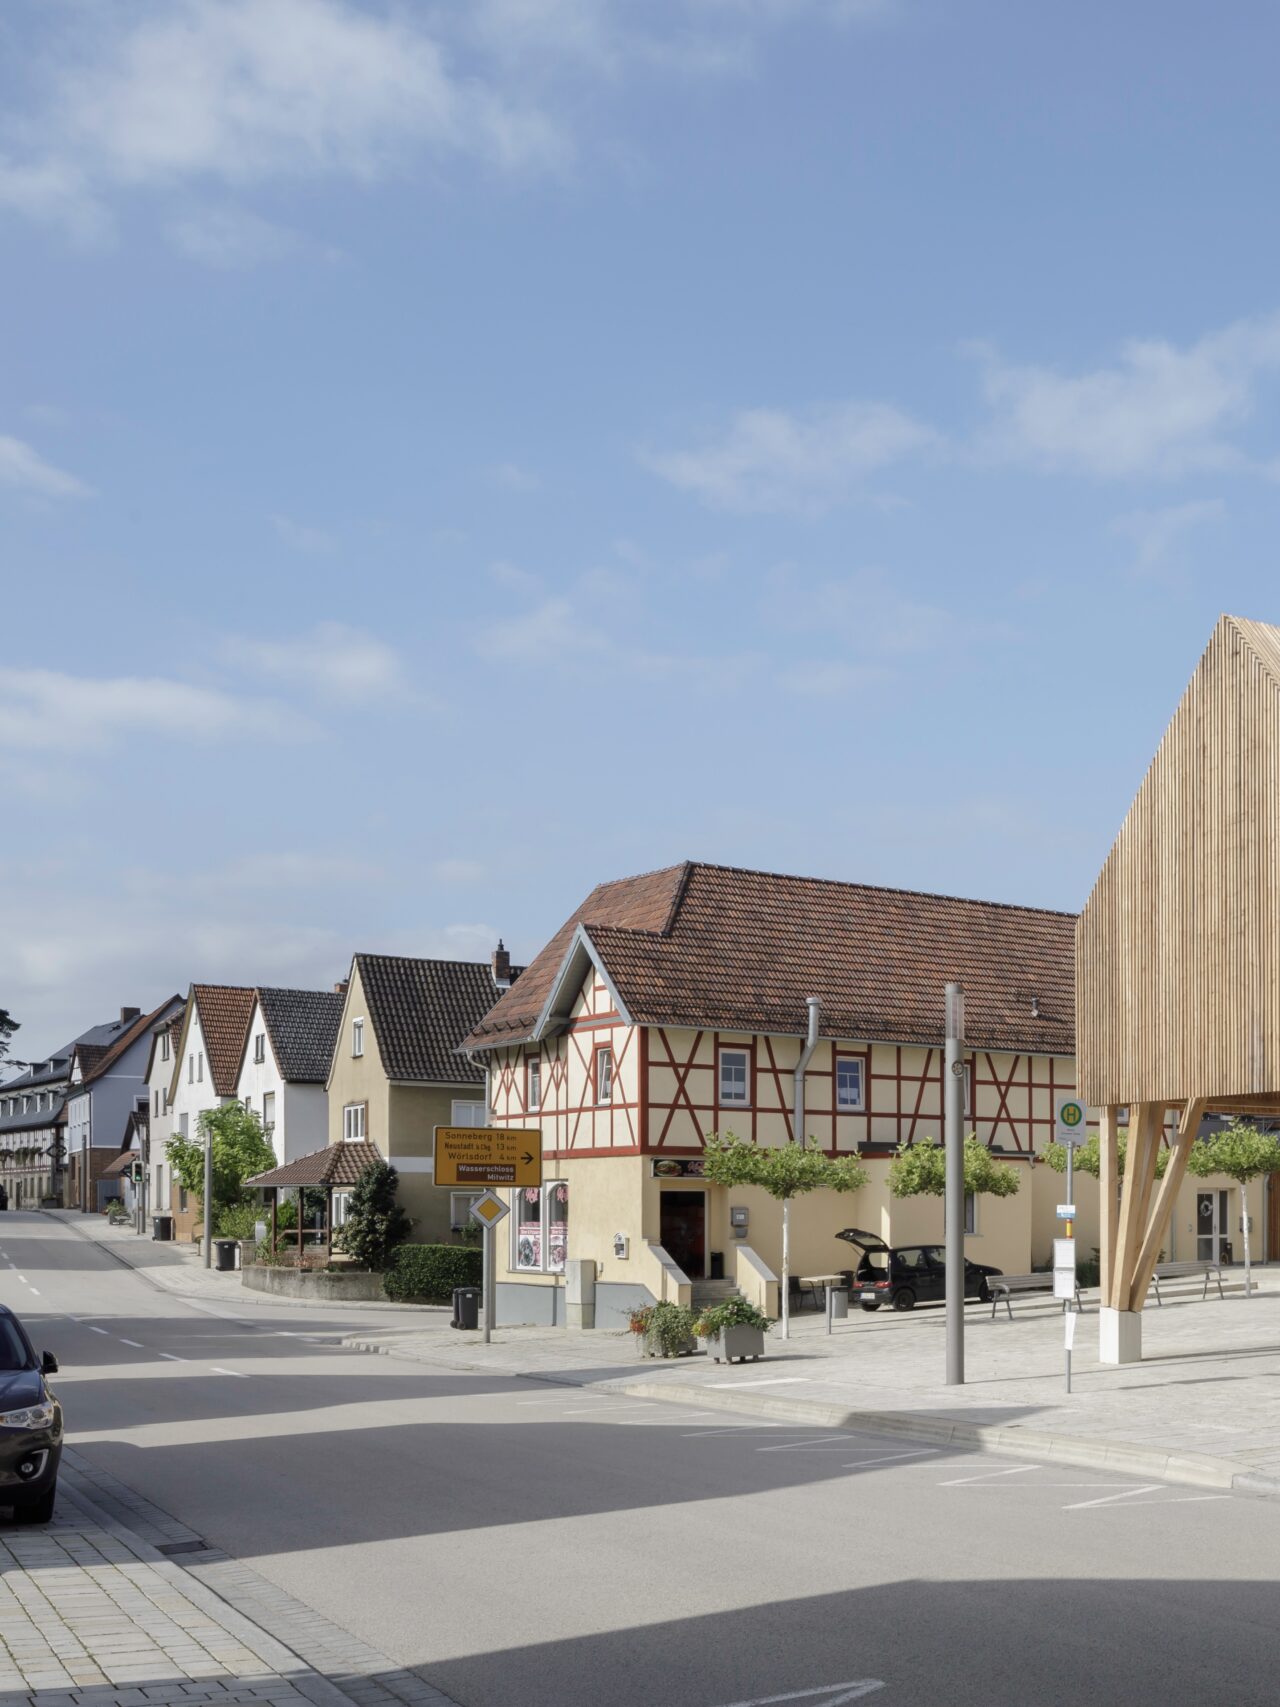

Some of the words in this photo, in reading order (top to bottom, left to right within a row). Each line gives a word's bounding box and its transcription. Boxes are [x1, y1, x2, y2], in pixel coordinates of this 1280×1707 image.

[1067, 1108, 1076, 1121] H
[445, 1131, 492, 1141] Sonneberg
[496, 1132, 505, 1140] 18
[444, 1142, 474, 1150] Neustadt
[448, 1152, 492, 1160] Wörlsdorf
[458, 1164, 514, 1173] Wasserschloss
[487, 1173, 514, 1181] Mitwitz
